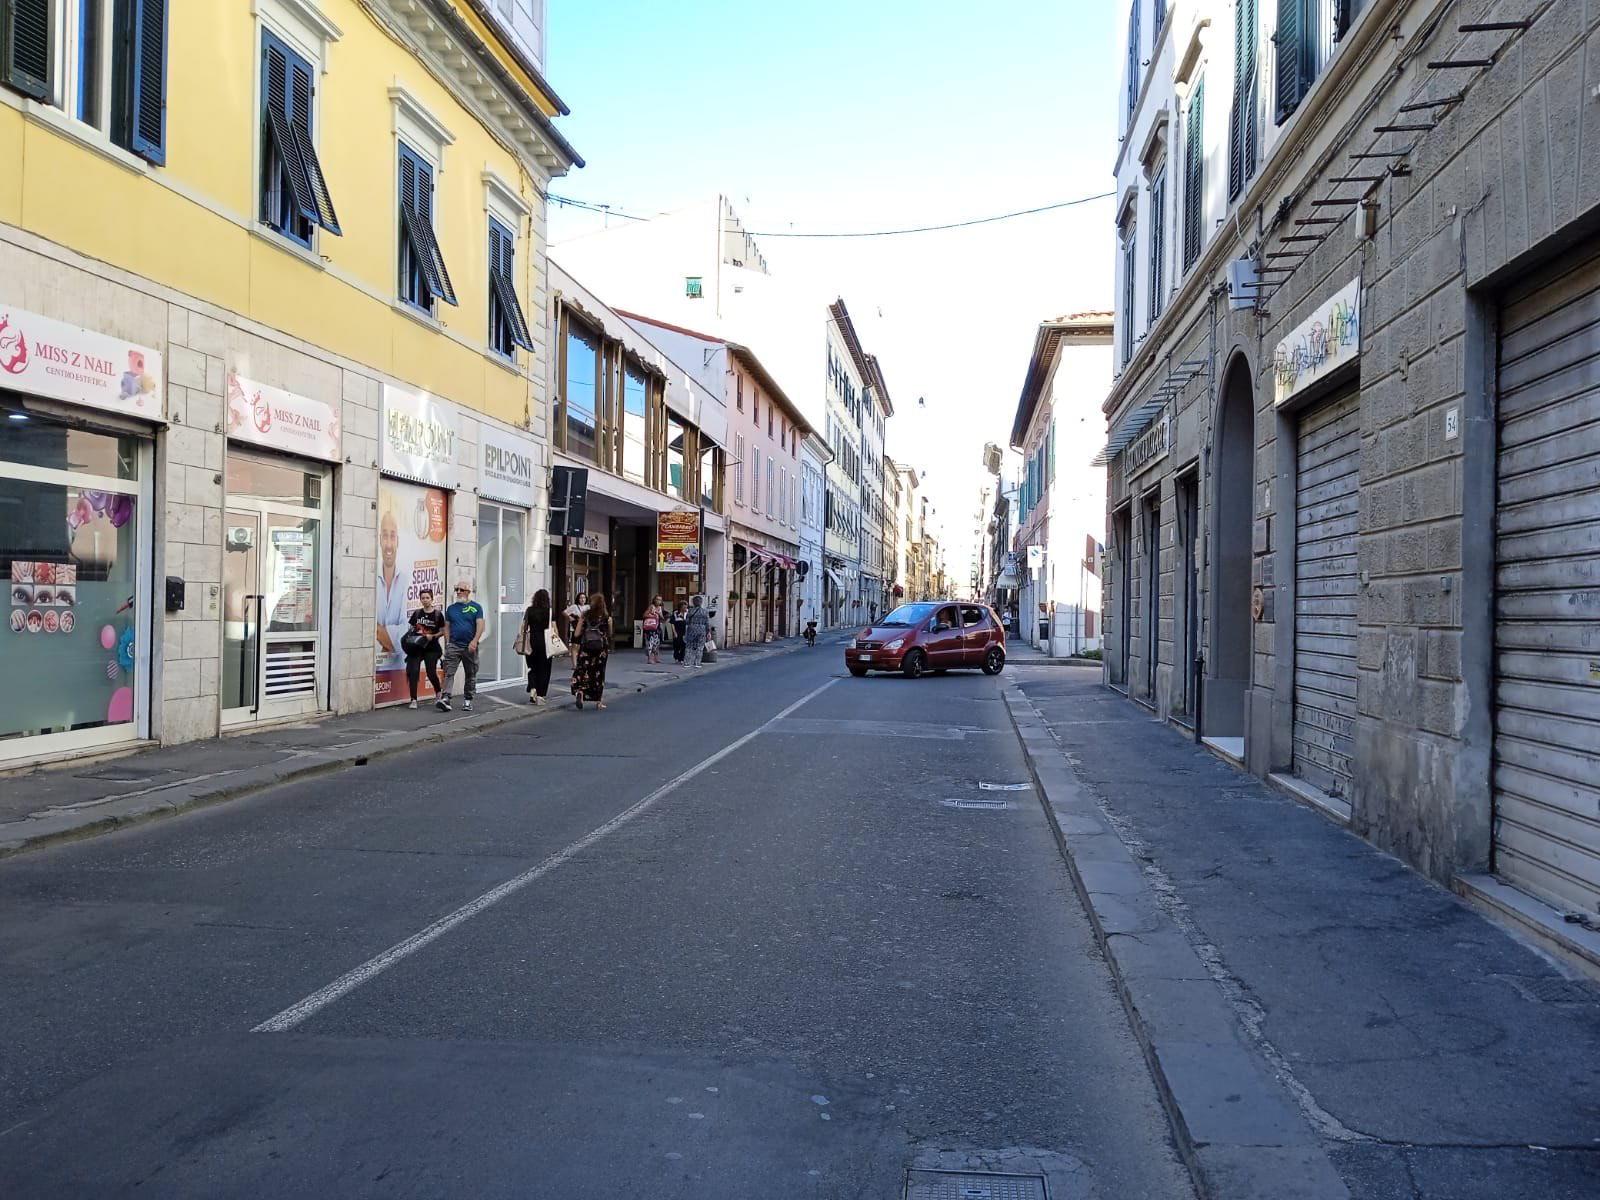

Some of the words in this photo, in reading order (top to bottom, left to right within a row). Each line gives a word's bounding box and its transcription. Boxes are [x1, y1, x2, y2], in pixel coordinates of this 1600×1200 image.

[34, 342, 68, 364] MISS
[71, 351, 81, 368] Z
[84, 355, 116, 376] NAIL
[45, 366, 75, 380] CENTRO
[274, 408, 294, 424] MISS
[294, 414, 301, 426] Z
[302, 416, 322, 432] NAIL
[1447, 415, 1456, 432] 54
[485, 443, 533, 480] EPILPOINT
[412, 567, 439, 585] SEDUTA
